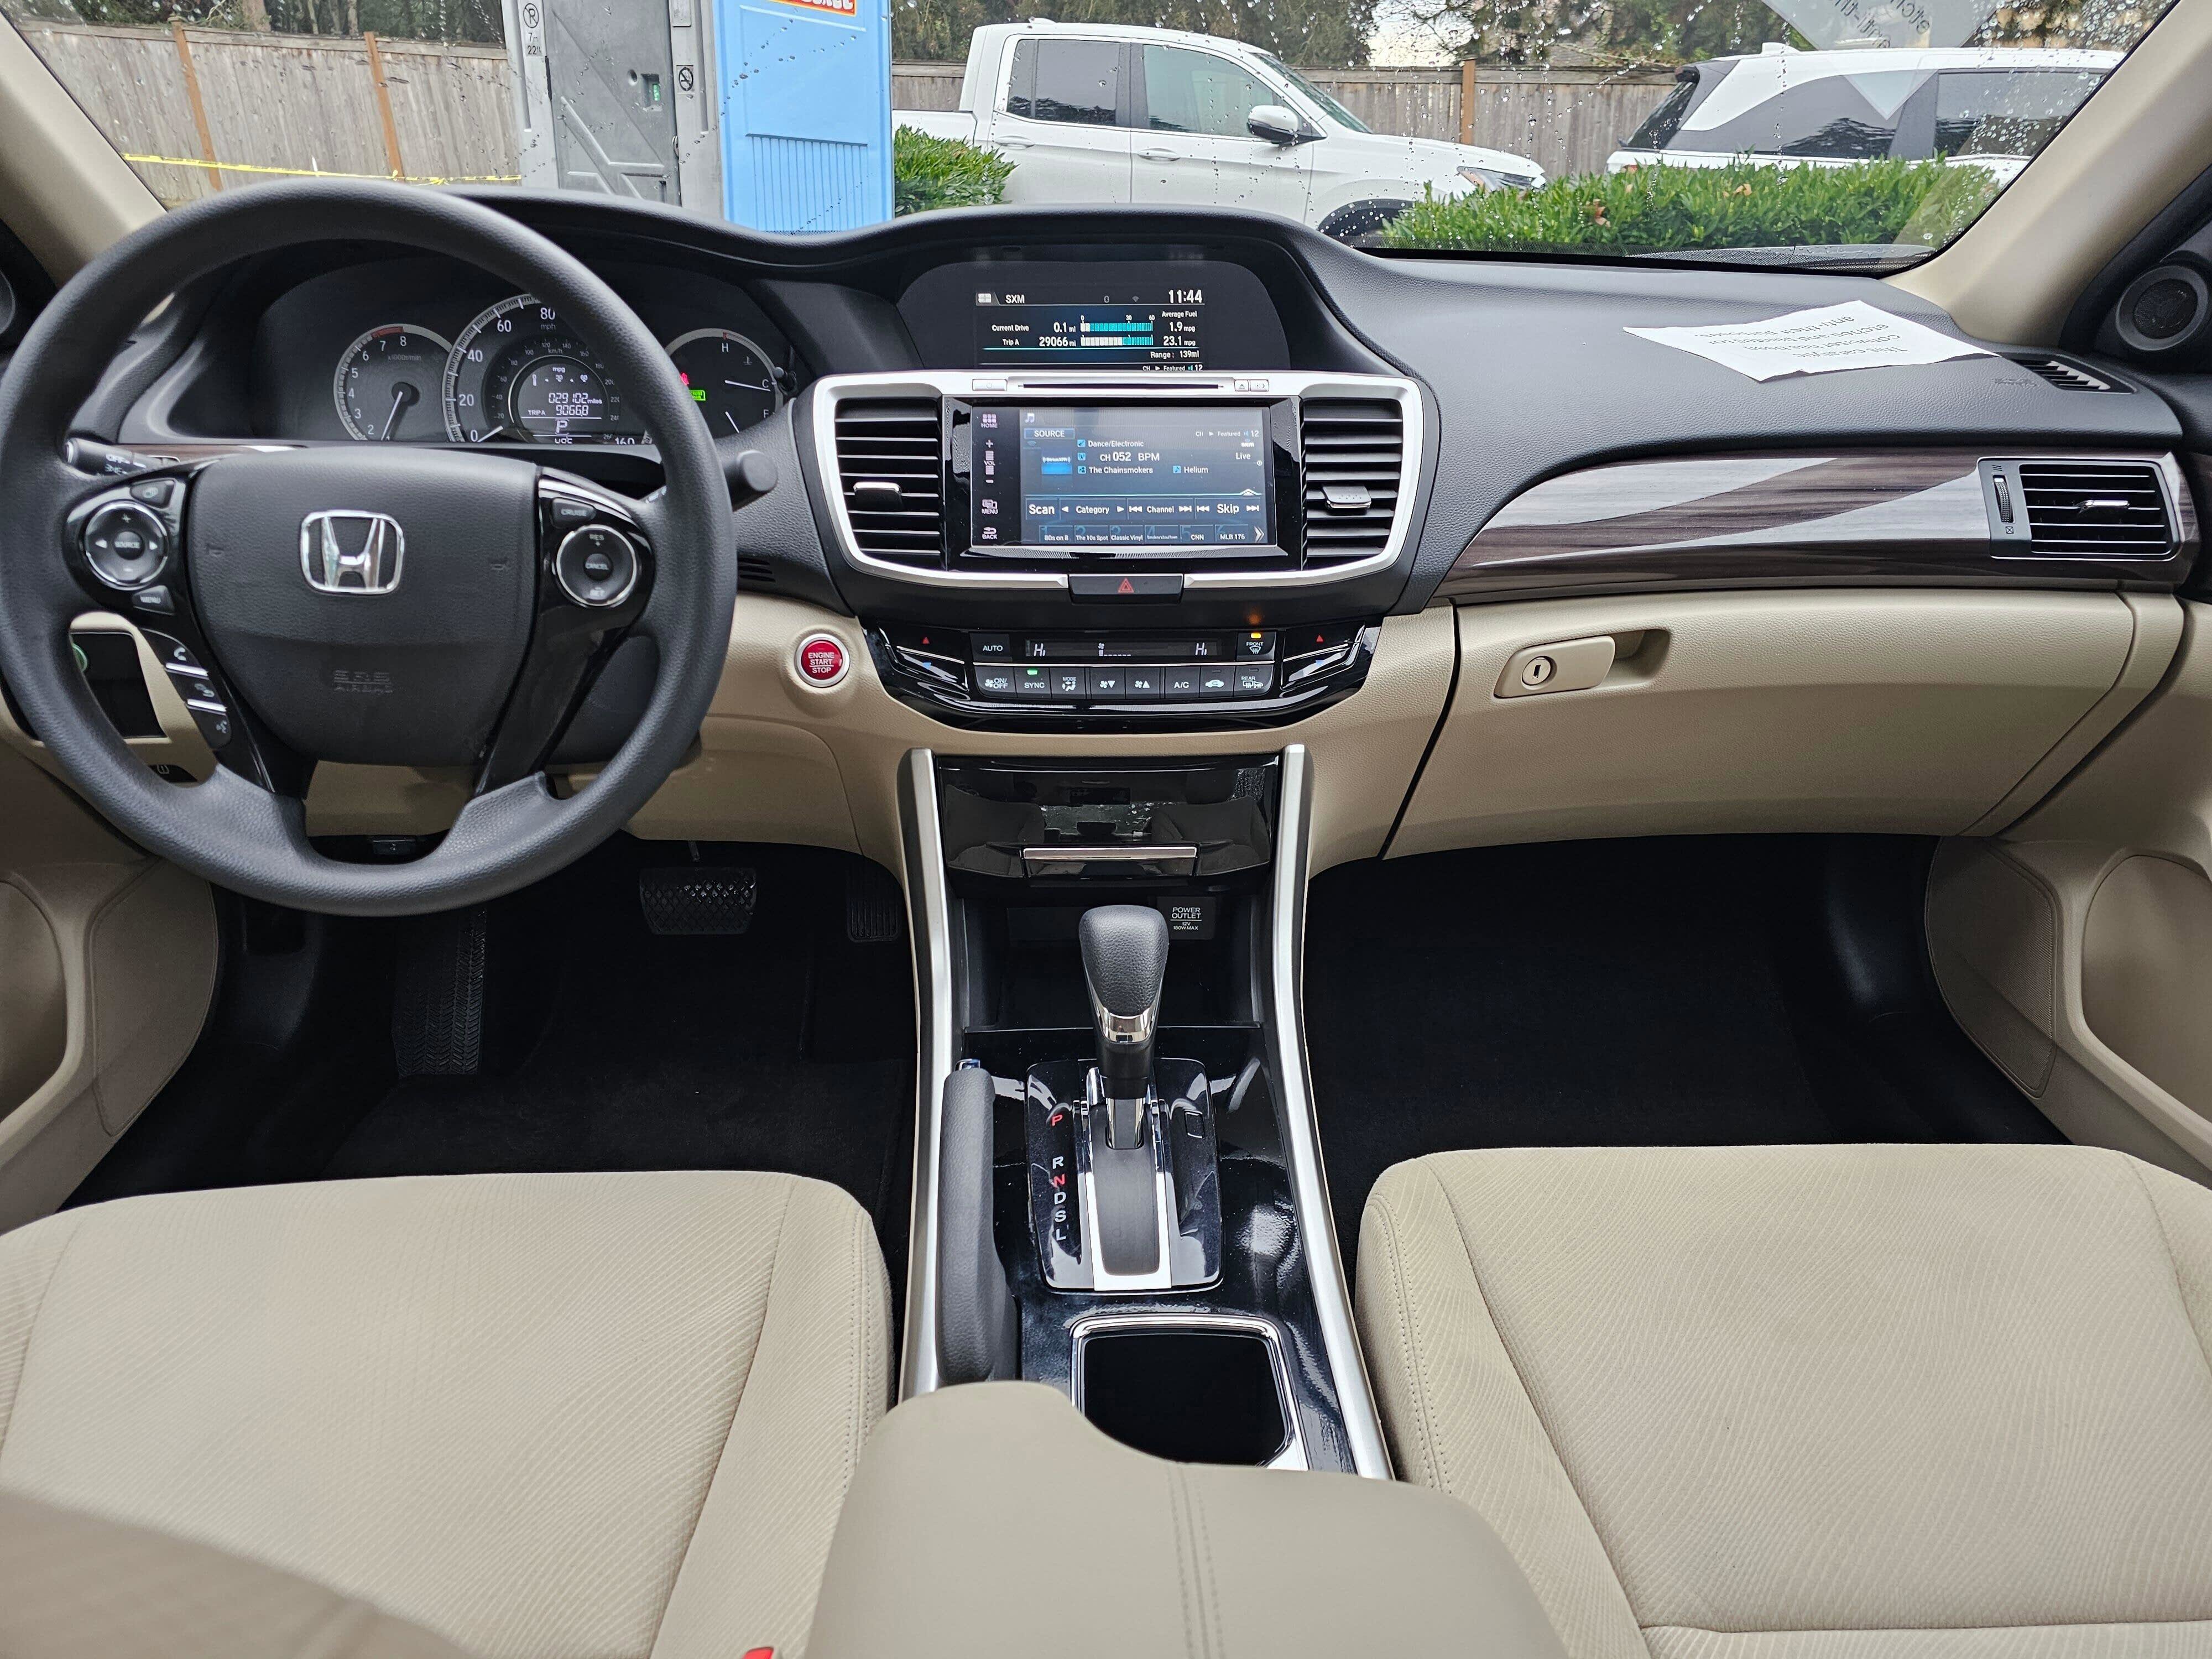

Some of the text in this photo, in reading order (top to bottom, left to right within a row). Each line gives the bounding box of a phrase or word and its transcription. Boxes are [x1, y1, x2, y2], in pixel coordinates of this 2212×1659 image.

[1005, 294, 1025, 304] SXM
[1168, 289, 1203, 304] 11:44
[540, 307, 556, 320] 80
[497, 320, 512, 332] 60
[1053, 322, 1067, 332] 0.1
[1169, 321, 1183, 332] 1.9
[1777, 316, 1854, 334] anti-theft
[1832, 324, 1889, 337] etched
[379, 340, 386, 351] 7
[400, 336, 407, 347] 8
[1039, 336, 1068, 347] 29066
[1163, 336, 1182, 346] 23.1
[1823, 334, 1900, 347] converter
[722, 343, 729, 352] H
[362, 351, 369, 361] 6
[467, 349, 483, 362] 40
[1180, 350, 1199, 358] 139mi
[1792, 349, 1866, 358] catalytic
[351, 368, 358, 378] 5
[761, 379, 769, 388] C
[348, 388, 354, 399] 4
[458, 394, 474, 406] 20
[354, 408, 362, 419] 3
[367, 424, 374, 435] 2
[556, 420, 568, 433] P
[470, 430, 478, 442] 0
[1113, 451, 1131, 462] 052
[1138, 452, 1160, 461] BPM
[1029, 504, 1055, 515] Scan
[1076, 505, 1110, 514] Category
[1217, 504, 1239, 514] Skip
[1052, 1114, 1063, 1126] P
[1052, 1156, 1064, 1169] R
[1053, 1173, 1065, 1187] N
[1054, 1192, 1066, 1204] D
[1055, 1210, 1066, 1222] S
[1056, 1229, 1067, 1241] L
